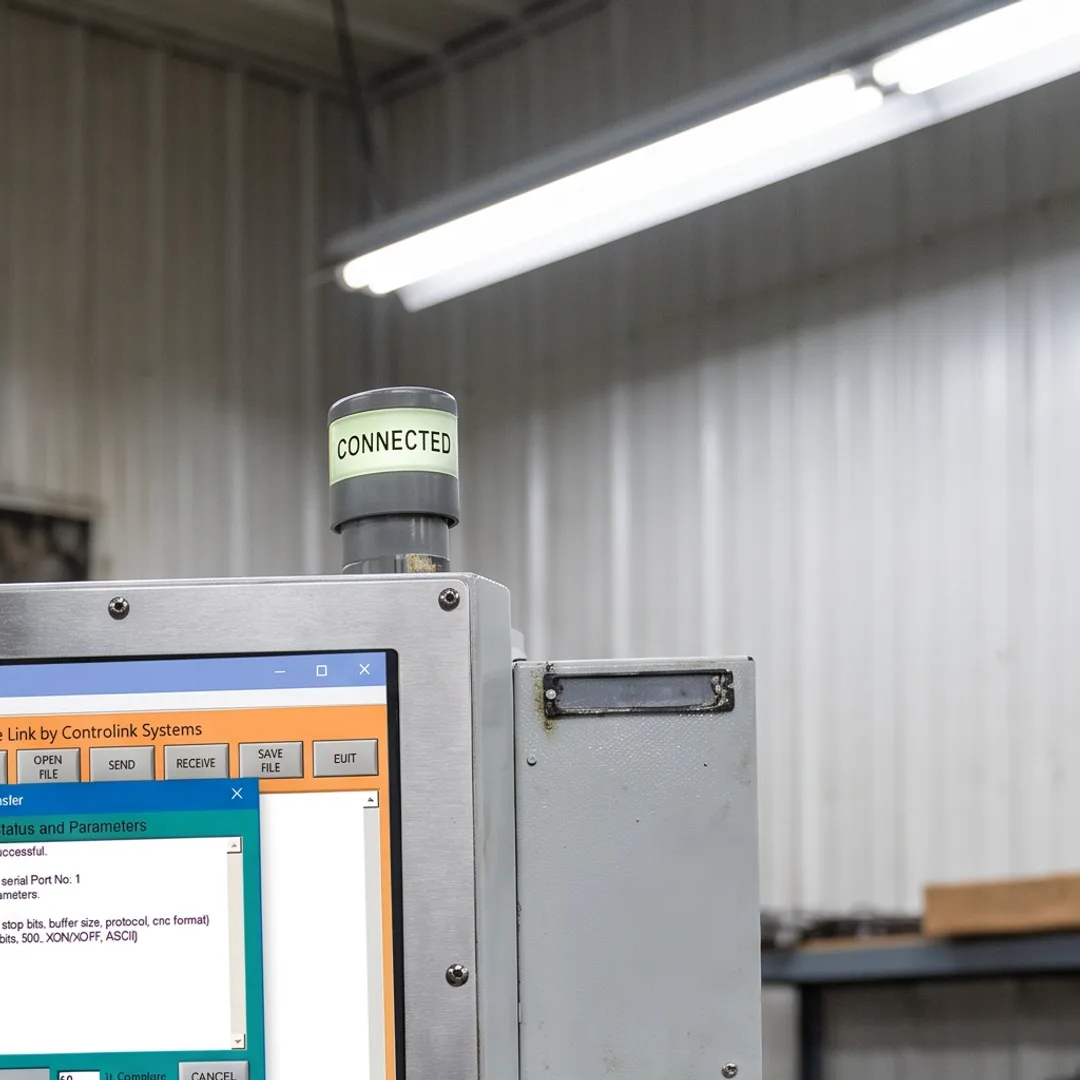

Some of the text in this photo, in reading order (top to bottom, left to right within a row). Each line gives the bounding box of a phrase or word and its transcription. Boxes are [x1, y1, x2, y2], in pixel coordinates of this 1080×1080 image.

[338, 430, 451, 459] CONNECTED
[8, 727, 36, 741] Link
[40, 726, 57, 743] by
[62, 724, 137, 740] Controlink
[142, 723, 202, 739] Systems
[259, 749, 283, 758] SAVE
[334, 753, 356, 764] EUIT
[34, 755, 62, 765] OPEN
[109, 760, 135, 770] SEND
[177, 758, 215, 768] RECEIVE
[262, 763, 280, 772] FILE
[40, 769, 58, 779] FILE
[40, 822, 64, 834] and
[70, 820, 146, 833] Parameters
[1, 875, 28, 886] serial
[31, 875, 52, 885] Port
[75, 874, 80, 883] 1
[2, 920, 23, 931] stop
[49, 918, 77, 928] buffer
[106, 916, 150, 929] protocol,
[153, 917, 170, 925] cnc
[173, 915, 209, 926] format)
